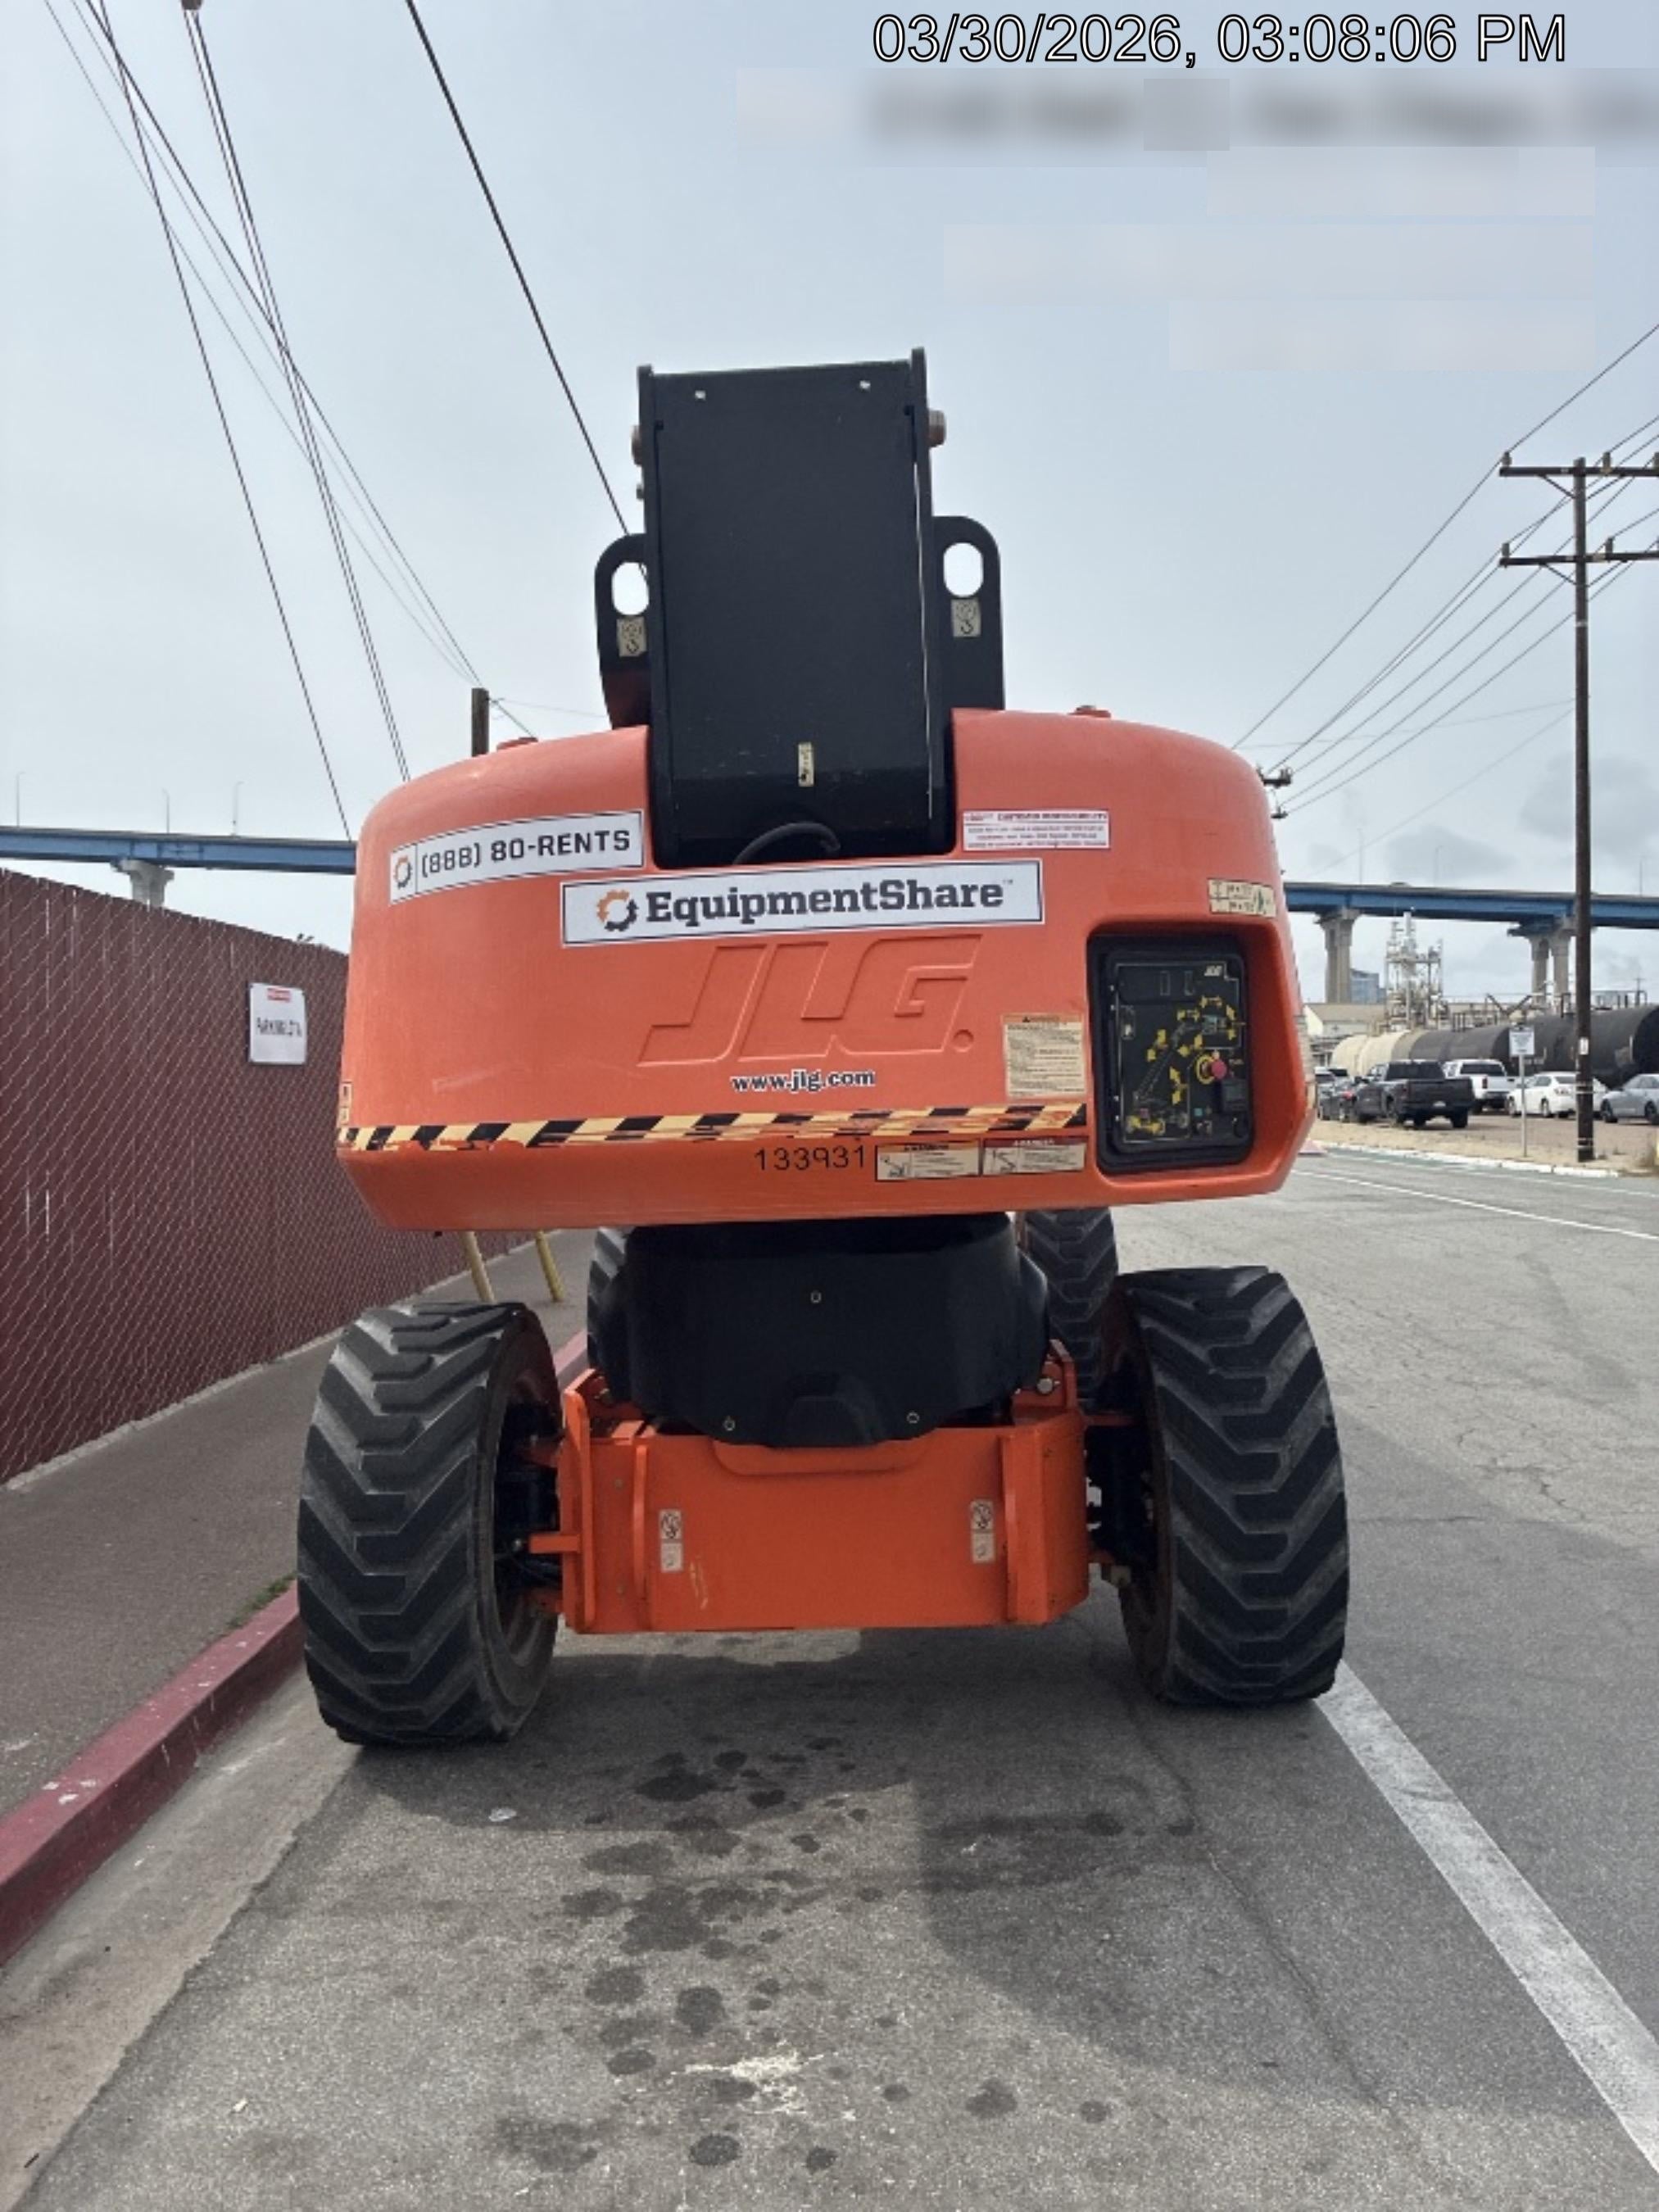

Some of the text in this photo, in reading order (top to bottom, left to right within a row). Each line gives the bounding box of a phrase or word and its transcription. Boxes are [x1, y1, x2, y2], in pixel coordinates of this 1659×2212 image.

[422, 829, 630, 877] (888) 80-RENTS
[646, 878, 1004, 928] EquipmentShare
[731, 1068, 876, 1093] www.jlg.com
[754, 1145, 864, 1171] 133931
